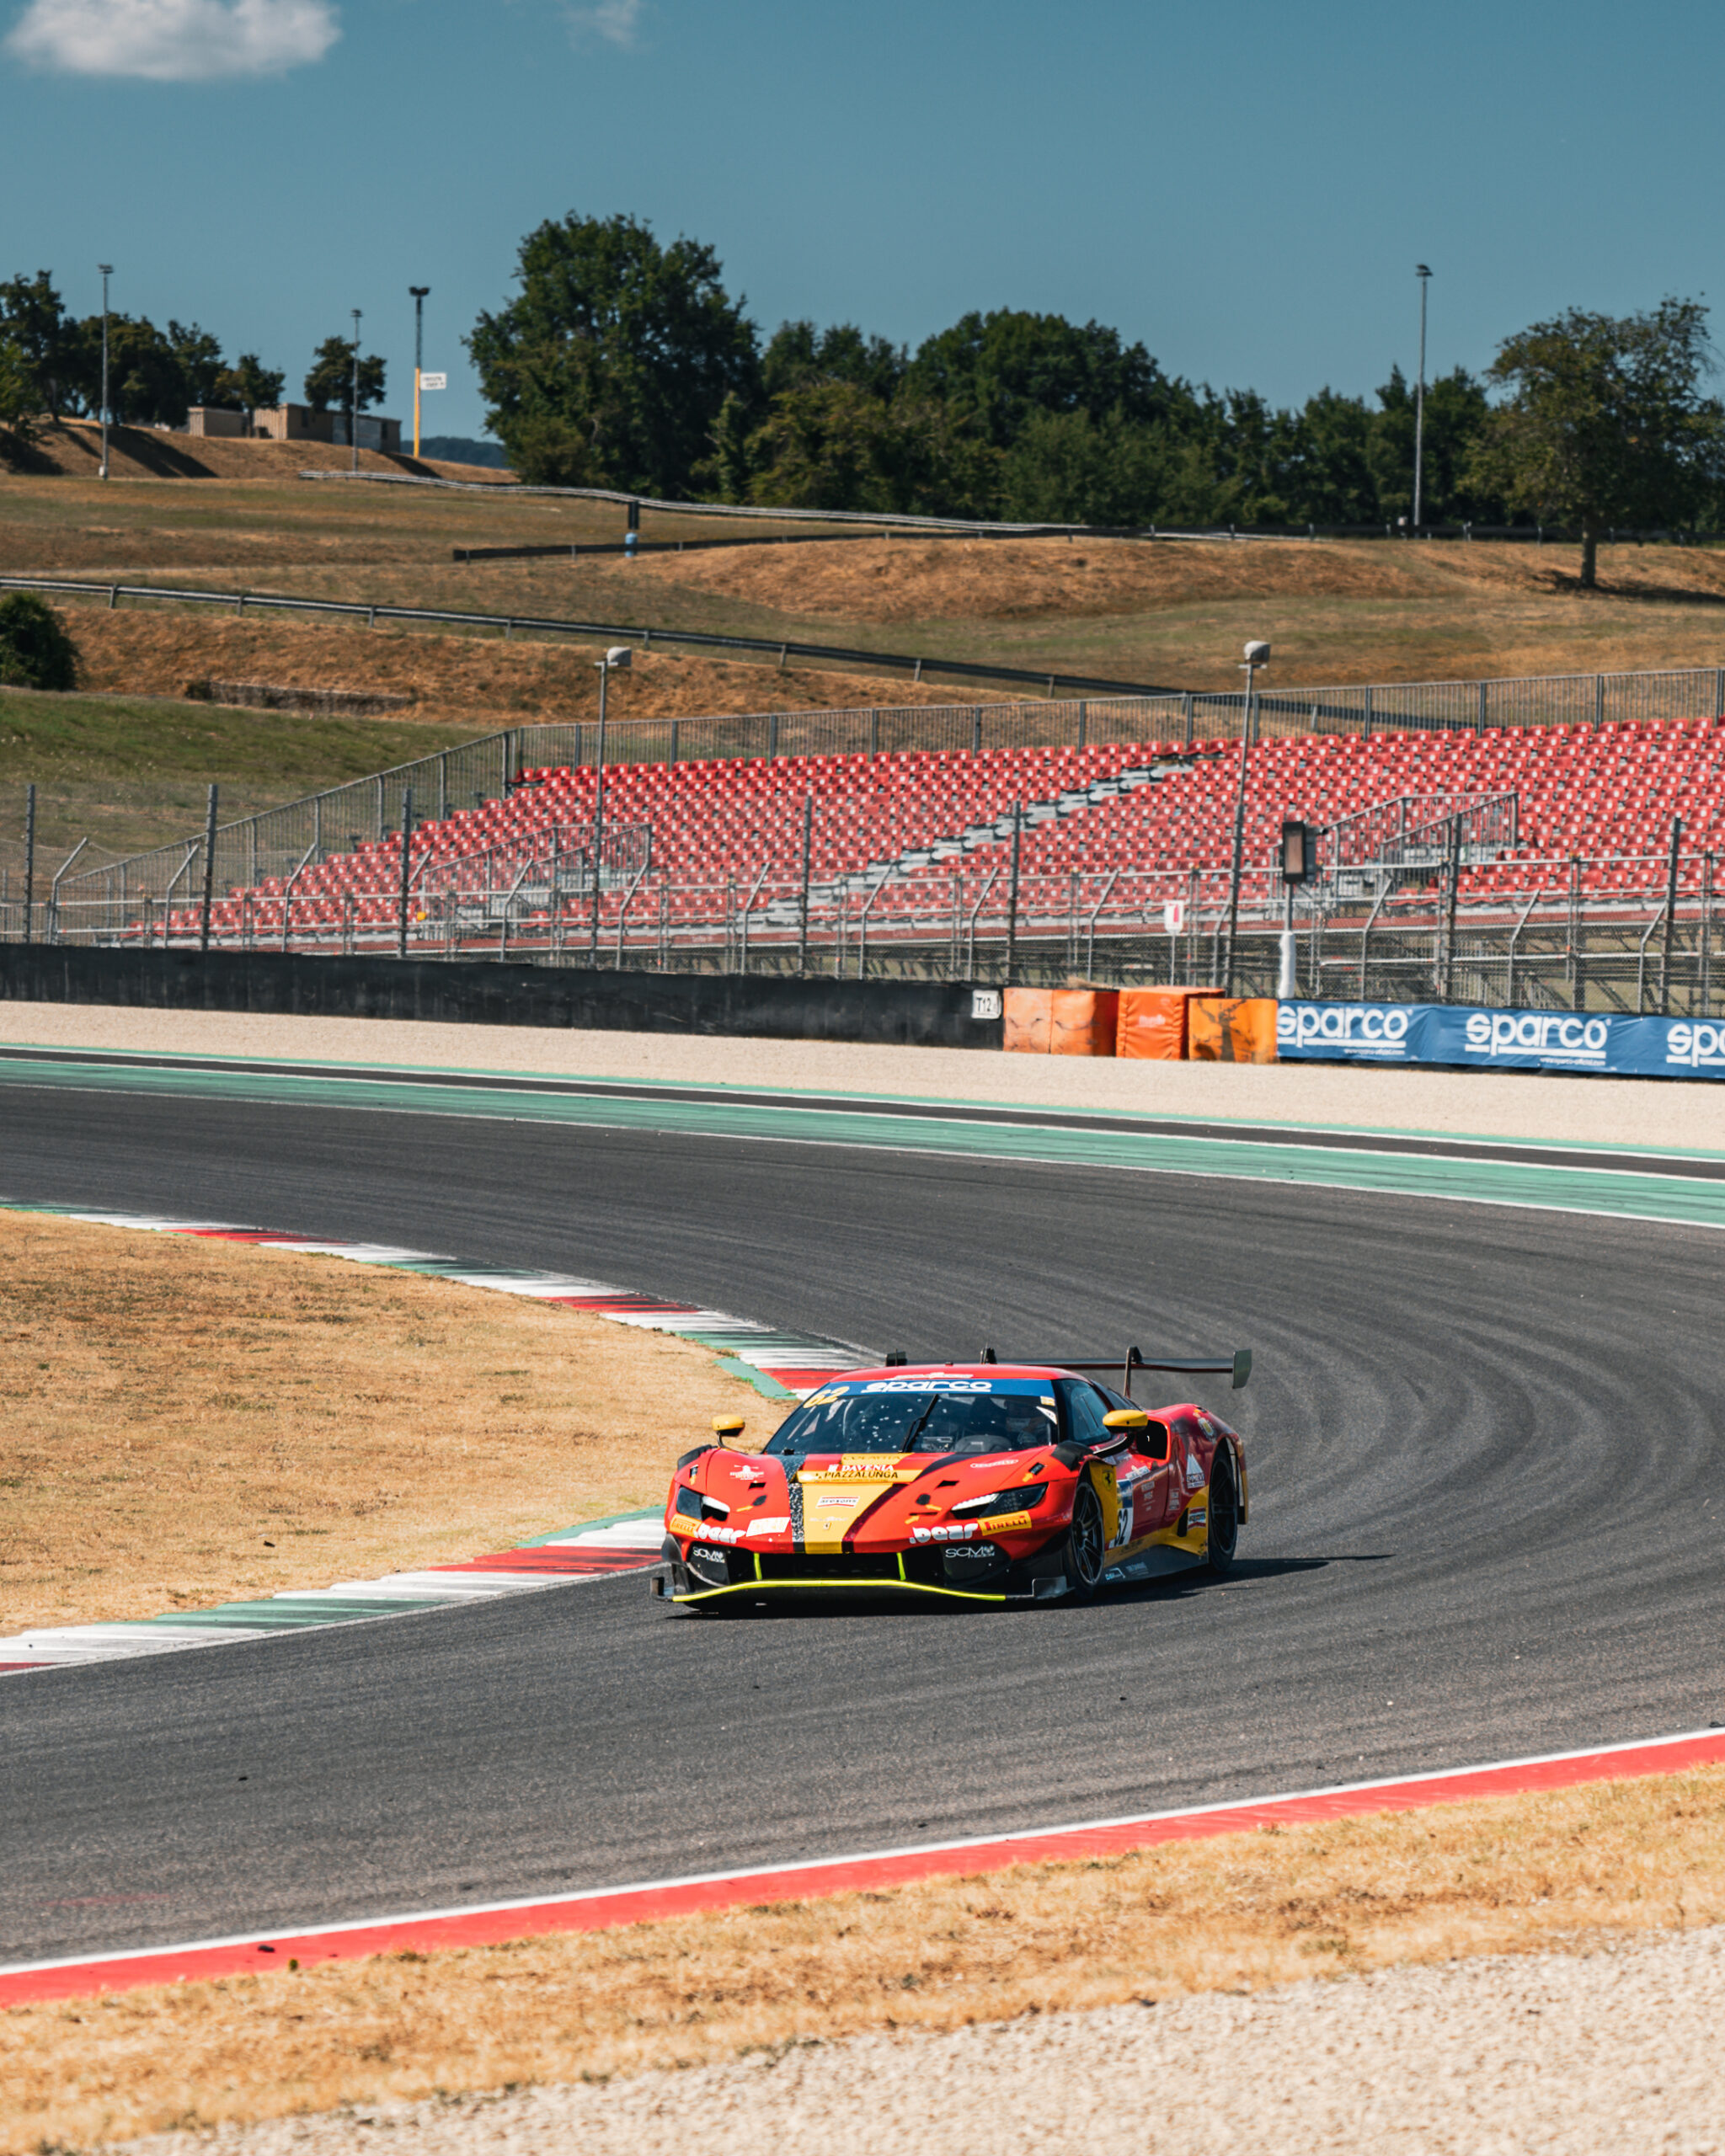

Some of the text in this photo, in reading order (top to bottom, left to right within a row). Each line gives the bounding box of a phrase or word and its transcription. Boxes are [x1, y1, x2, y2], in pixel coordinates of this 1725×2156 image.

[1277, 1006, 1408, 1048] sparco
[1466, 1013, 1607, 1056] sparco
[1668, 1024, 1725, 1067] sp
[804, 1386, 850, 1408] 62
[866, 1380, 992, 1392] sparco
[985, 1515, 1028, 1531] PIRELLI
